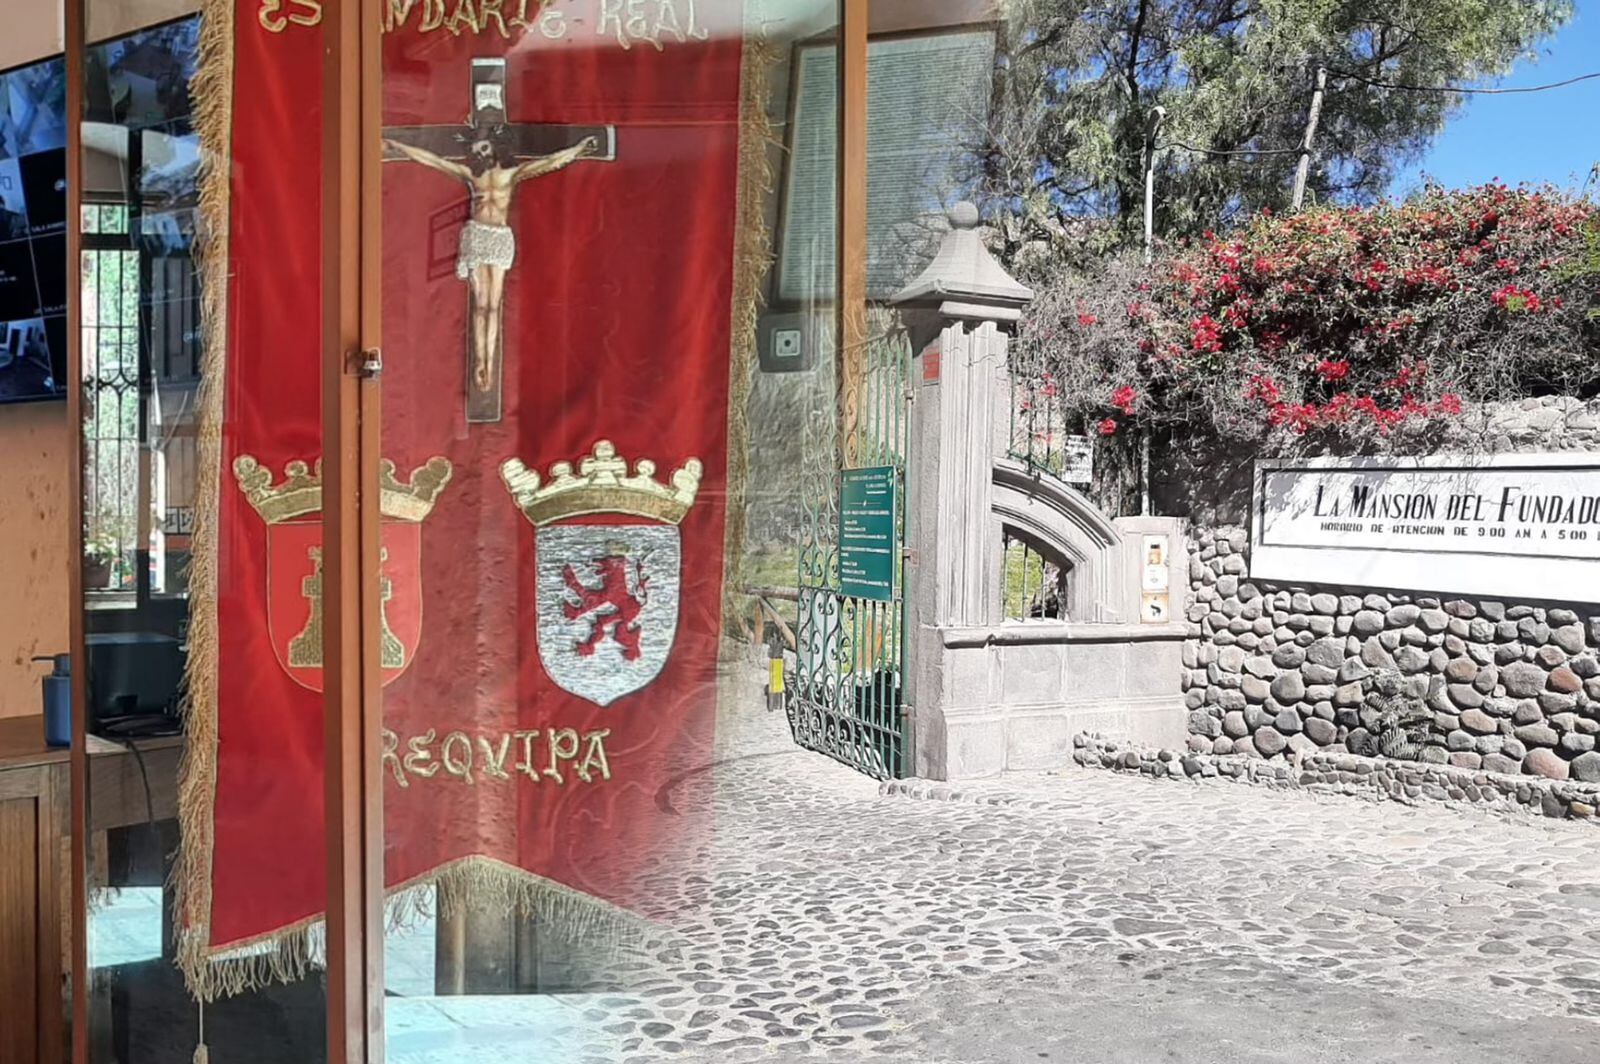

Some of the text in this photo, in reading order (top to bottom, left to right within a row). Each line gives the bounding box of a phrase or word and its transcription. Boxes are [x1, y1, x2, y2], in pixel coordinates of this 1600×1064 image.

[597, 0, 708, 51] REAL
[1313, 485, 1339, 517] LA
[1349, 485, 1438, 520] MANSION
[1446, 494, 1485, 521] DEL
[1320, 522, 1363, 533] HORARIO
[1371, 524, 1384, 533] DE
[1392, 525, 1445, 536] ATENCION
[1454, 527, 1468, 536] DE
[382, 728, 612, 787] REQVIPA
